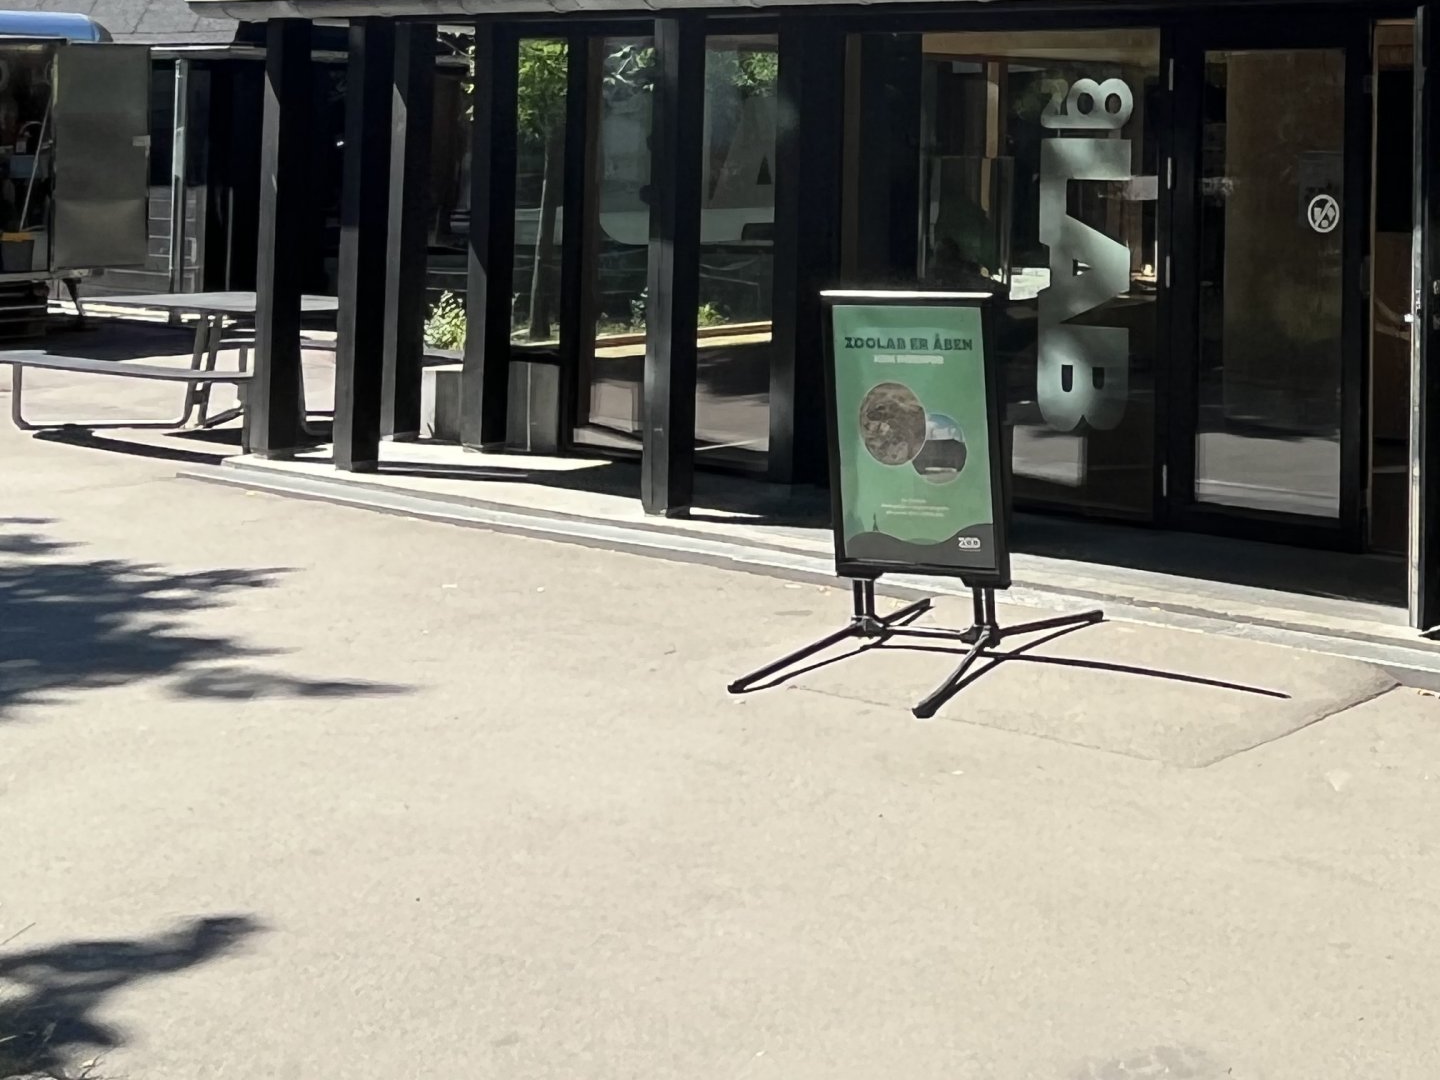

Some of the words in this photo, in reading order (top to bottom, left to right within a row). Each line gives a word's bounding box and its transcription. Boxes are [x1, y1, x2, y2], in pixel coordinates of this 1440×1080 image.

[844, 336, 906, 350] ZOOLAB
[911, 337, 929, 351] ER
[933, 333, 973, 351] ÅBEN
[1037, 138, 1131, 432] LAB
